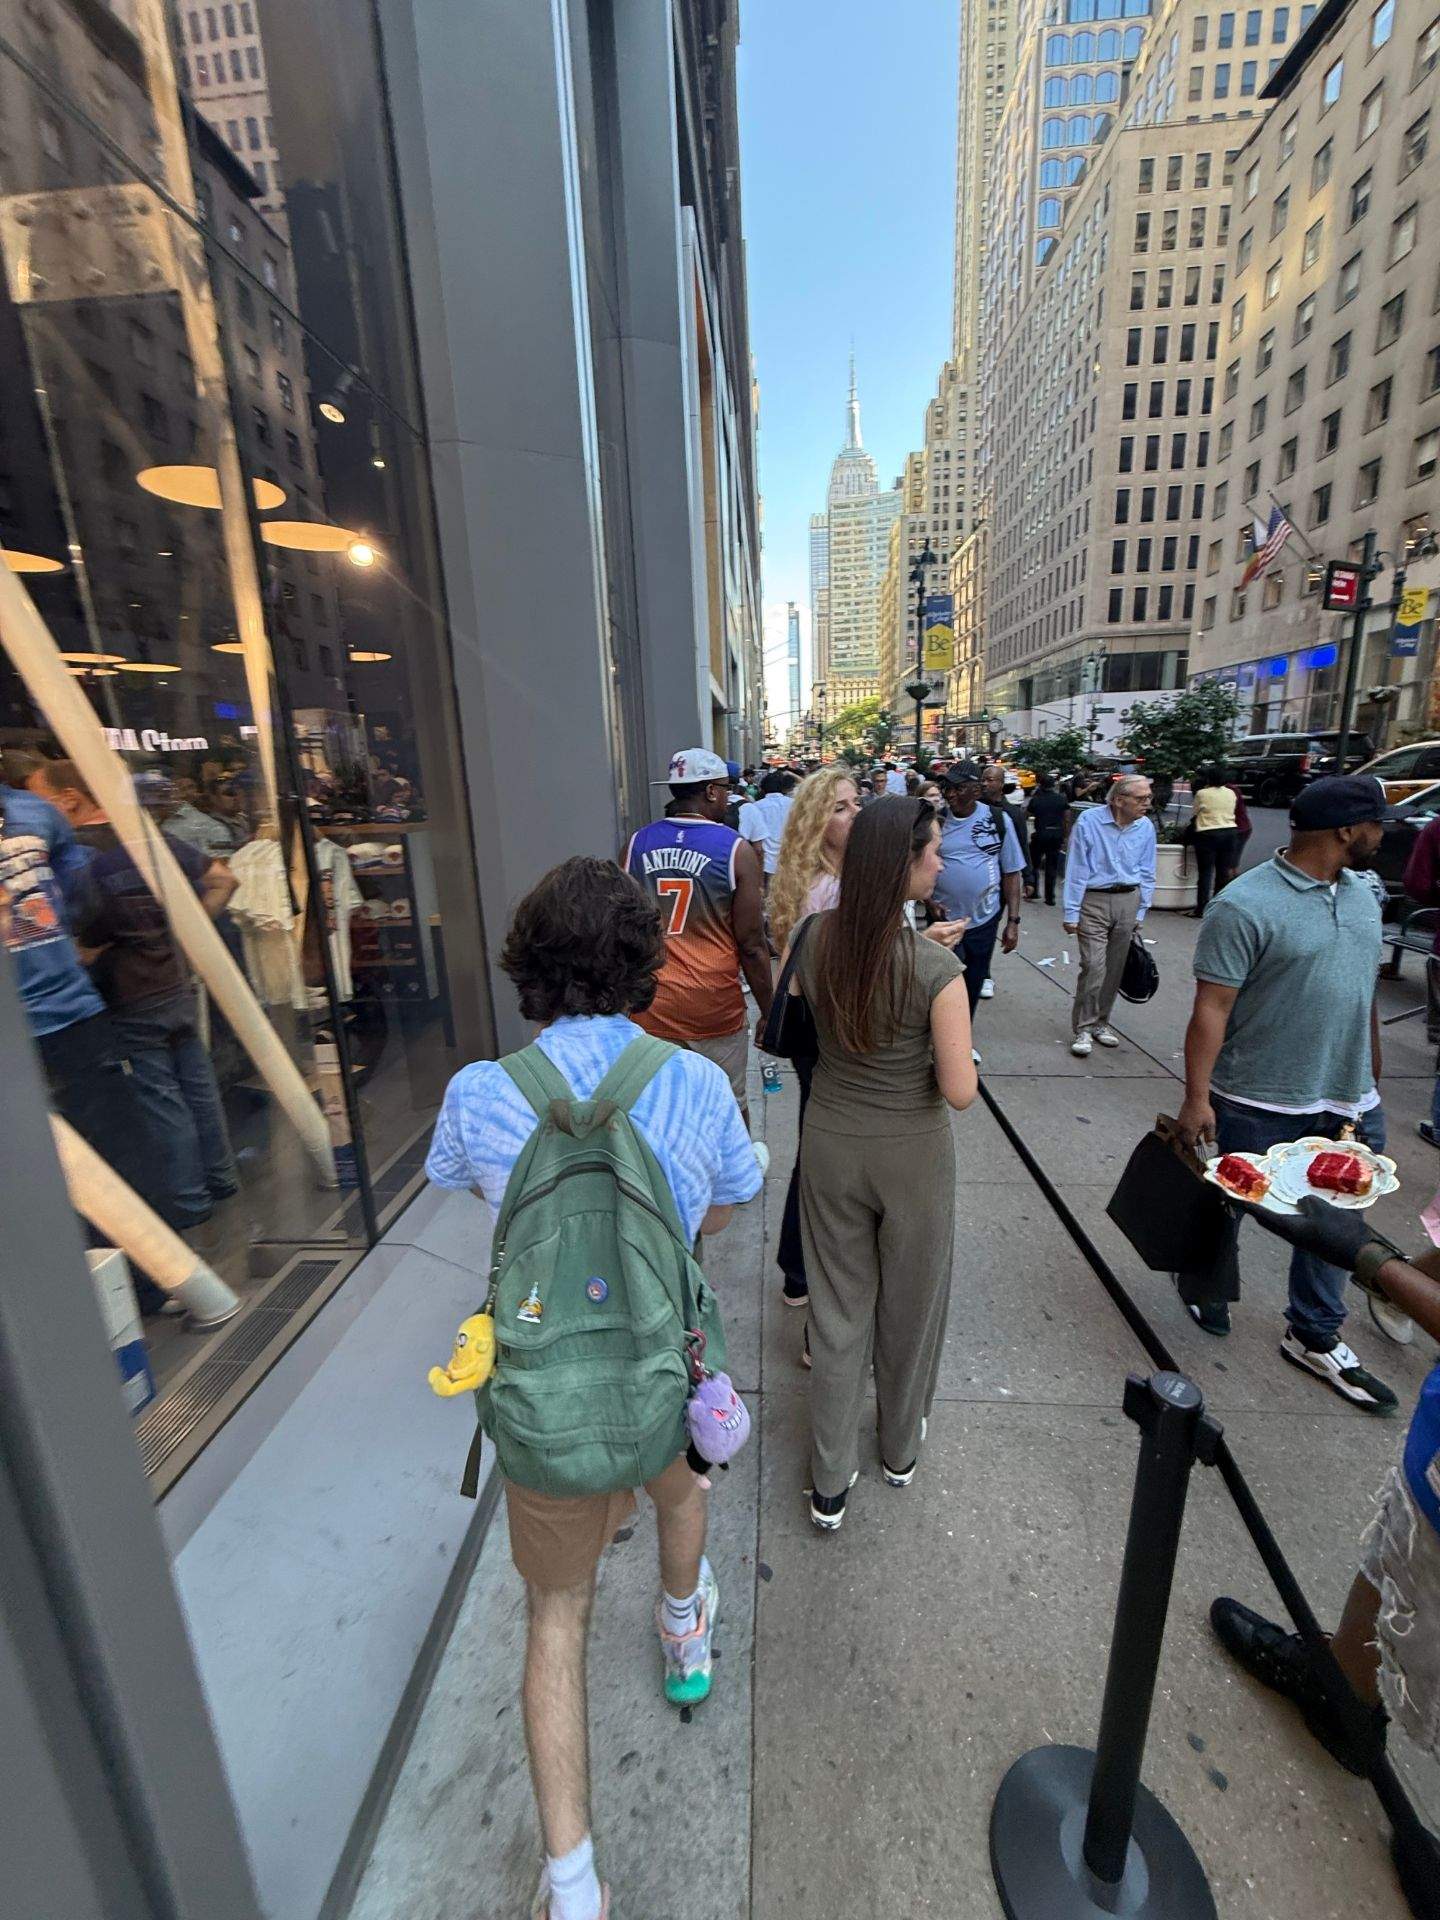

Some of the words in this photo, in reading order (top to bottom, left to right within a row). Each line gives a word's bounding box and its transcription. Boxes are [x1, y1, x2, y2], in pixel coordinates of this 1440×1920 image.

[927, 634, 950, 652] Be
[641, 847, 712, 877] ANTHONY
[656, 877, 694, 935] 7
[763, 1067, 774, 1078] G
